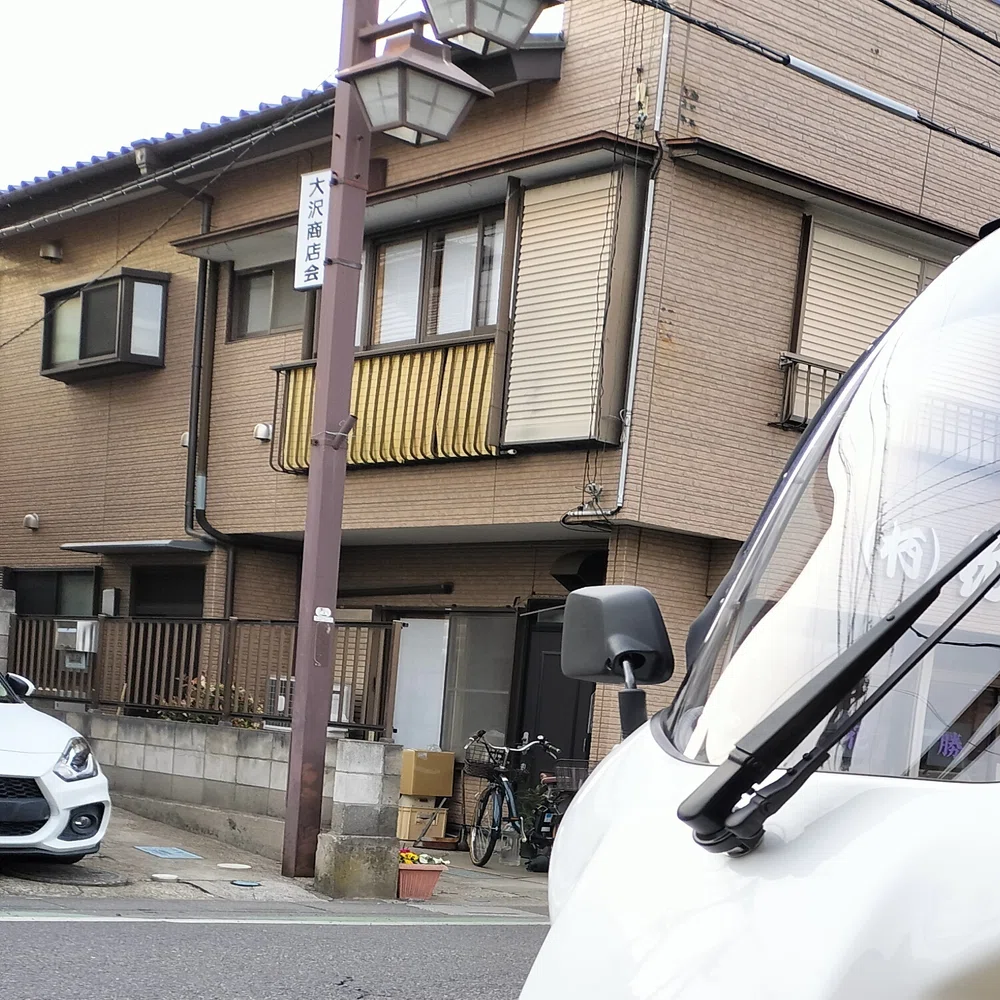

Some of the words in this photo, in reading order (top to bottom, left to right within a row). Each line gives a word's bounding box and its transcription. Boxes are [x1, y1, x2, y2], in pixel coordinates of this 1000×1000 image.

[304, 177, 326, 283] 大沢商店会
